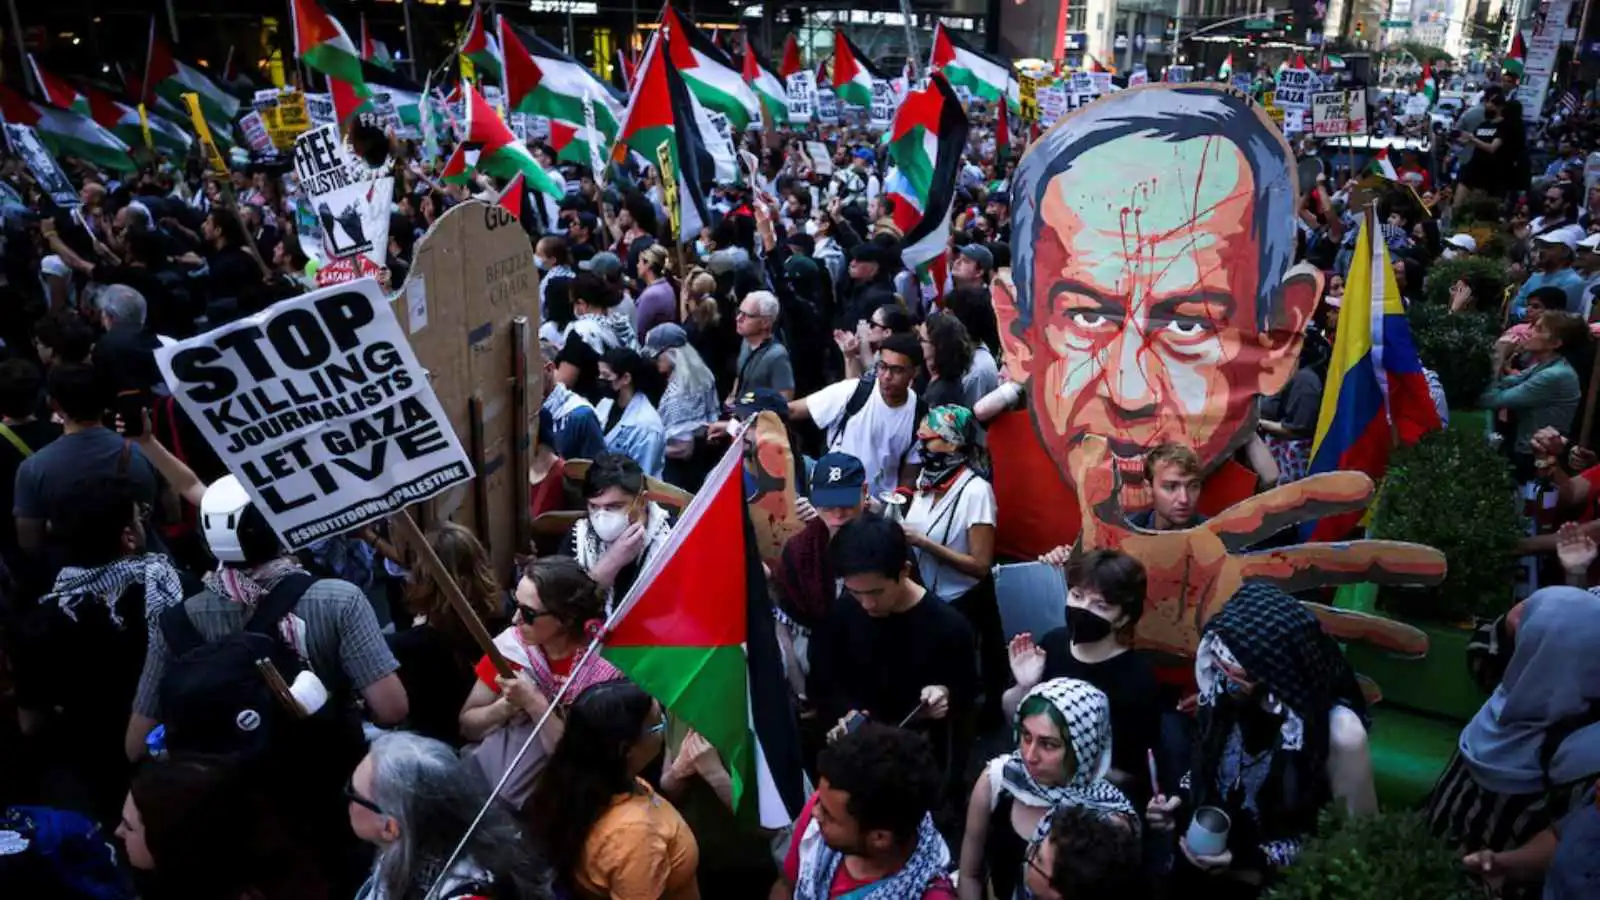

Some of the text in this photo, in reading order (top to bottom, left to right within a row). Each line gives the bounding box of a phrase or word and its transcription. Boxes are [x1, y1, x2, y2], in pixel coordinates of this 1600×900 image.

[1281, 71, 1310, 84] STOP
[1324, 104, 1353, 120] FRE
[296, 127, 343, 180] FREE
[171, 291, 375, 403] STOP
[203, 341, 404, 435] KILLING
[227, 369, 413, 454] JOURNALISTS
[241, 396, 433, 488] LET GAZA
[258, 420, 450, 514] LIVE
[289, 466, 466, 545] #SHUTITDOWN4PALESTINE
